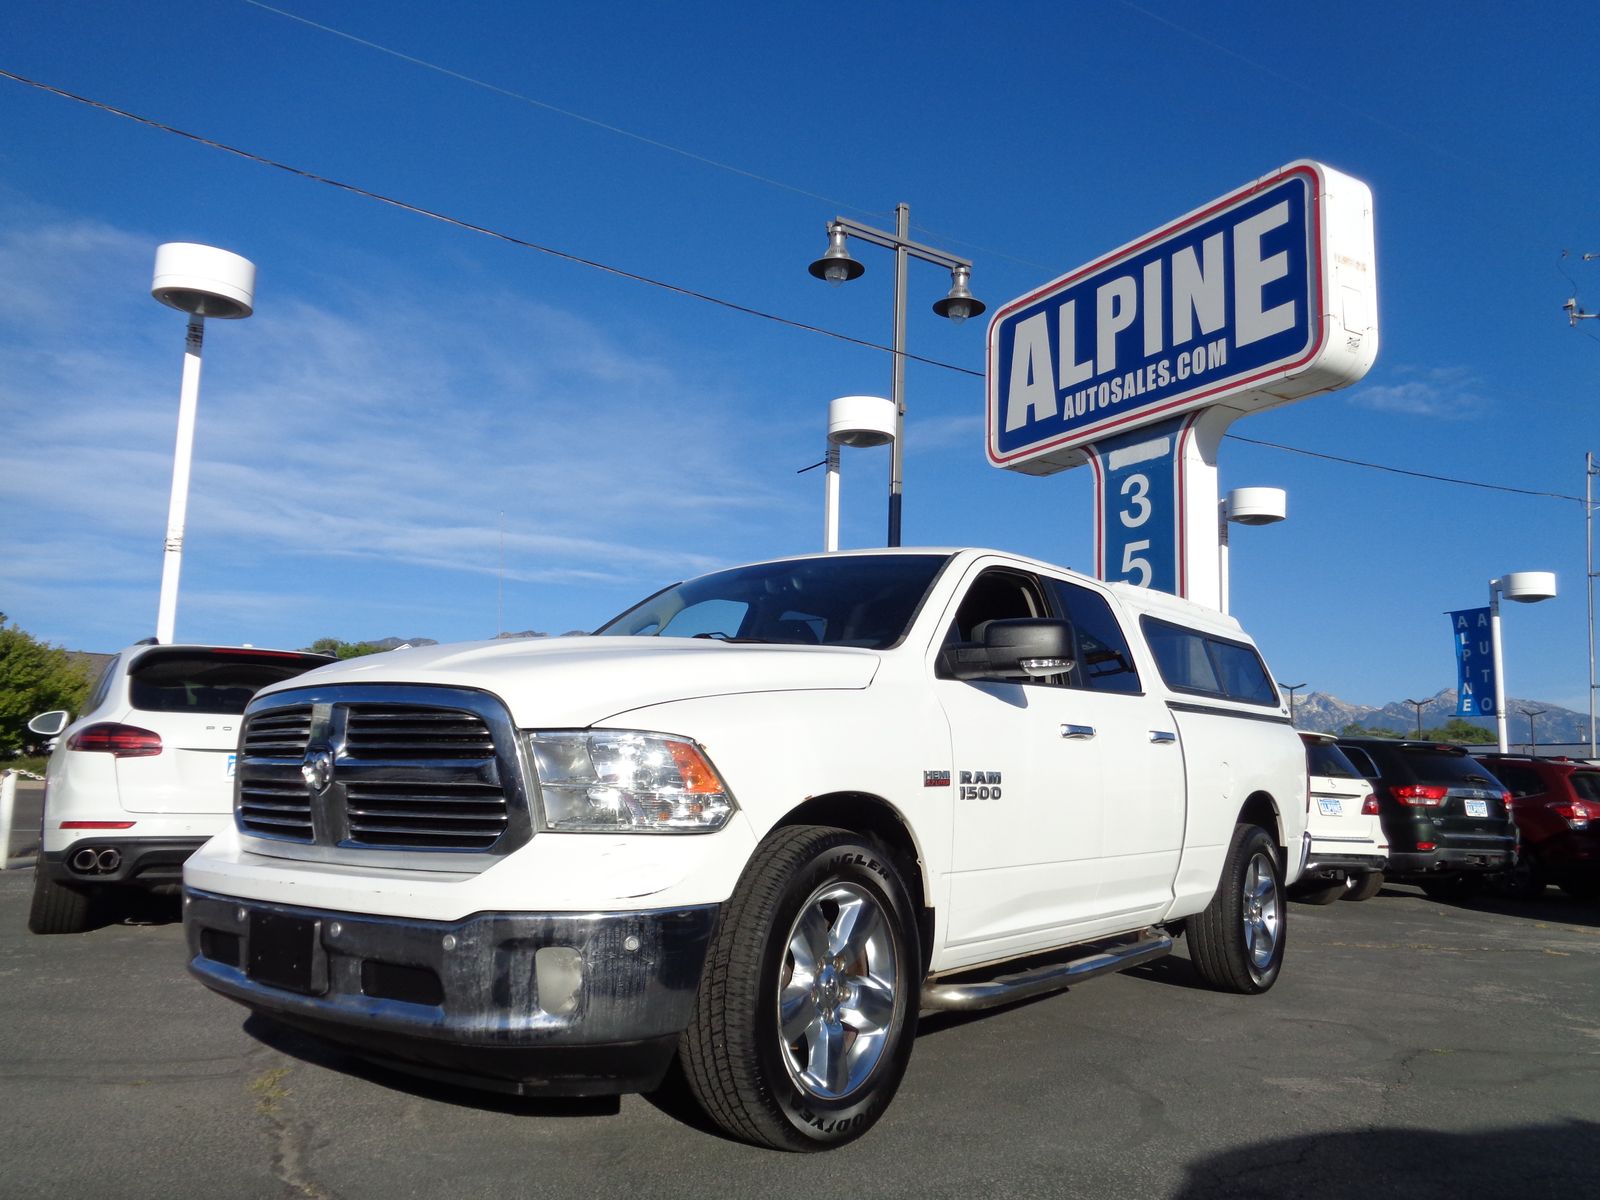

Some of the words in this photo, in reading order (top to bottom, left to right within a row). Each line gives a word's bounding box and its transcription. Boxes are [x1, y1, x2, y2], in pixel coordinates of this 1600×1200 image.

[1005, 200, 1295, 432] ALPINE
[1063, 338, 1227, 420] AUTOSALES.COM
[1457, 616, 1473, 712] ALPINE
[1477, 613, 1493, 711] AUTO
[923, 770, 950, 779] HEMI
[959, 771, 1002, 785] RAM
[959, 786, 1002, 801] 1500
